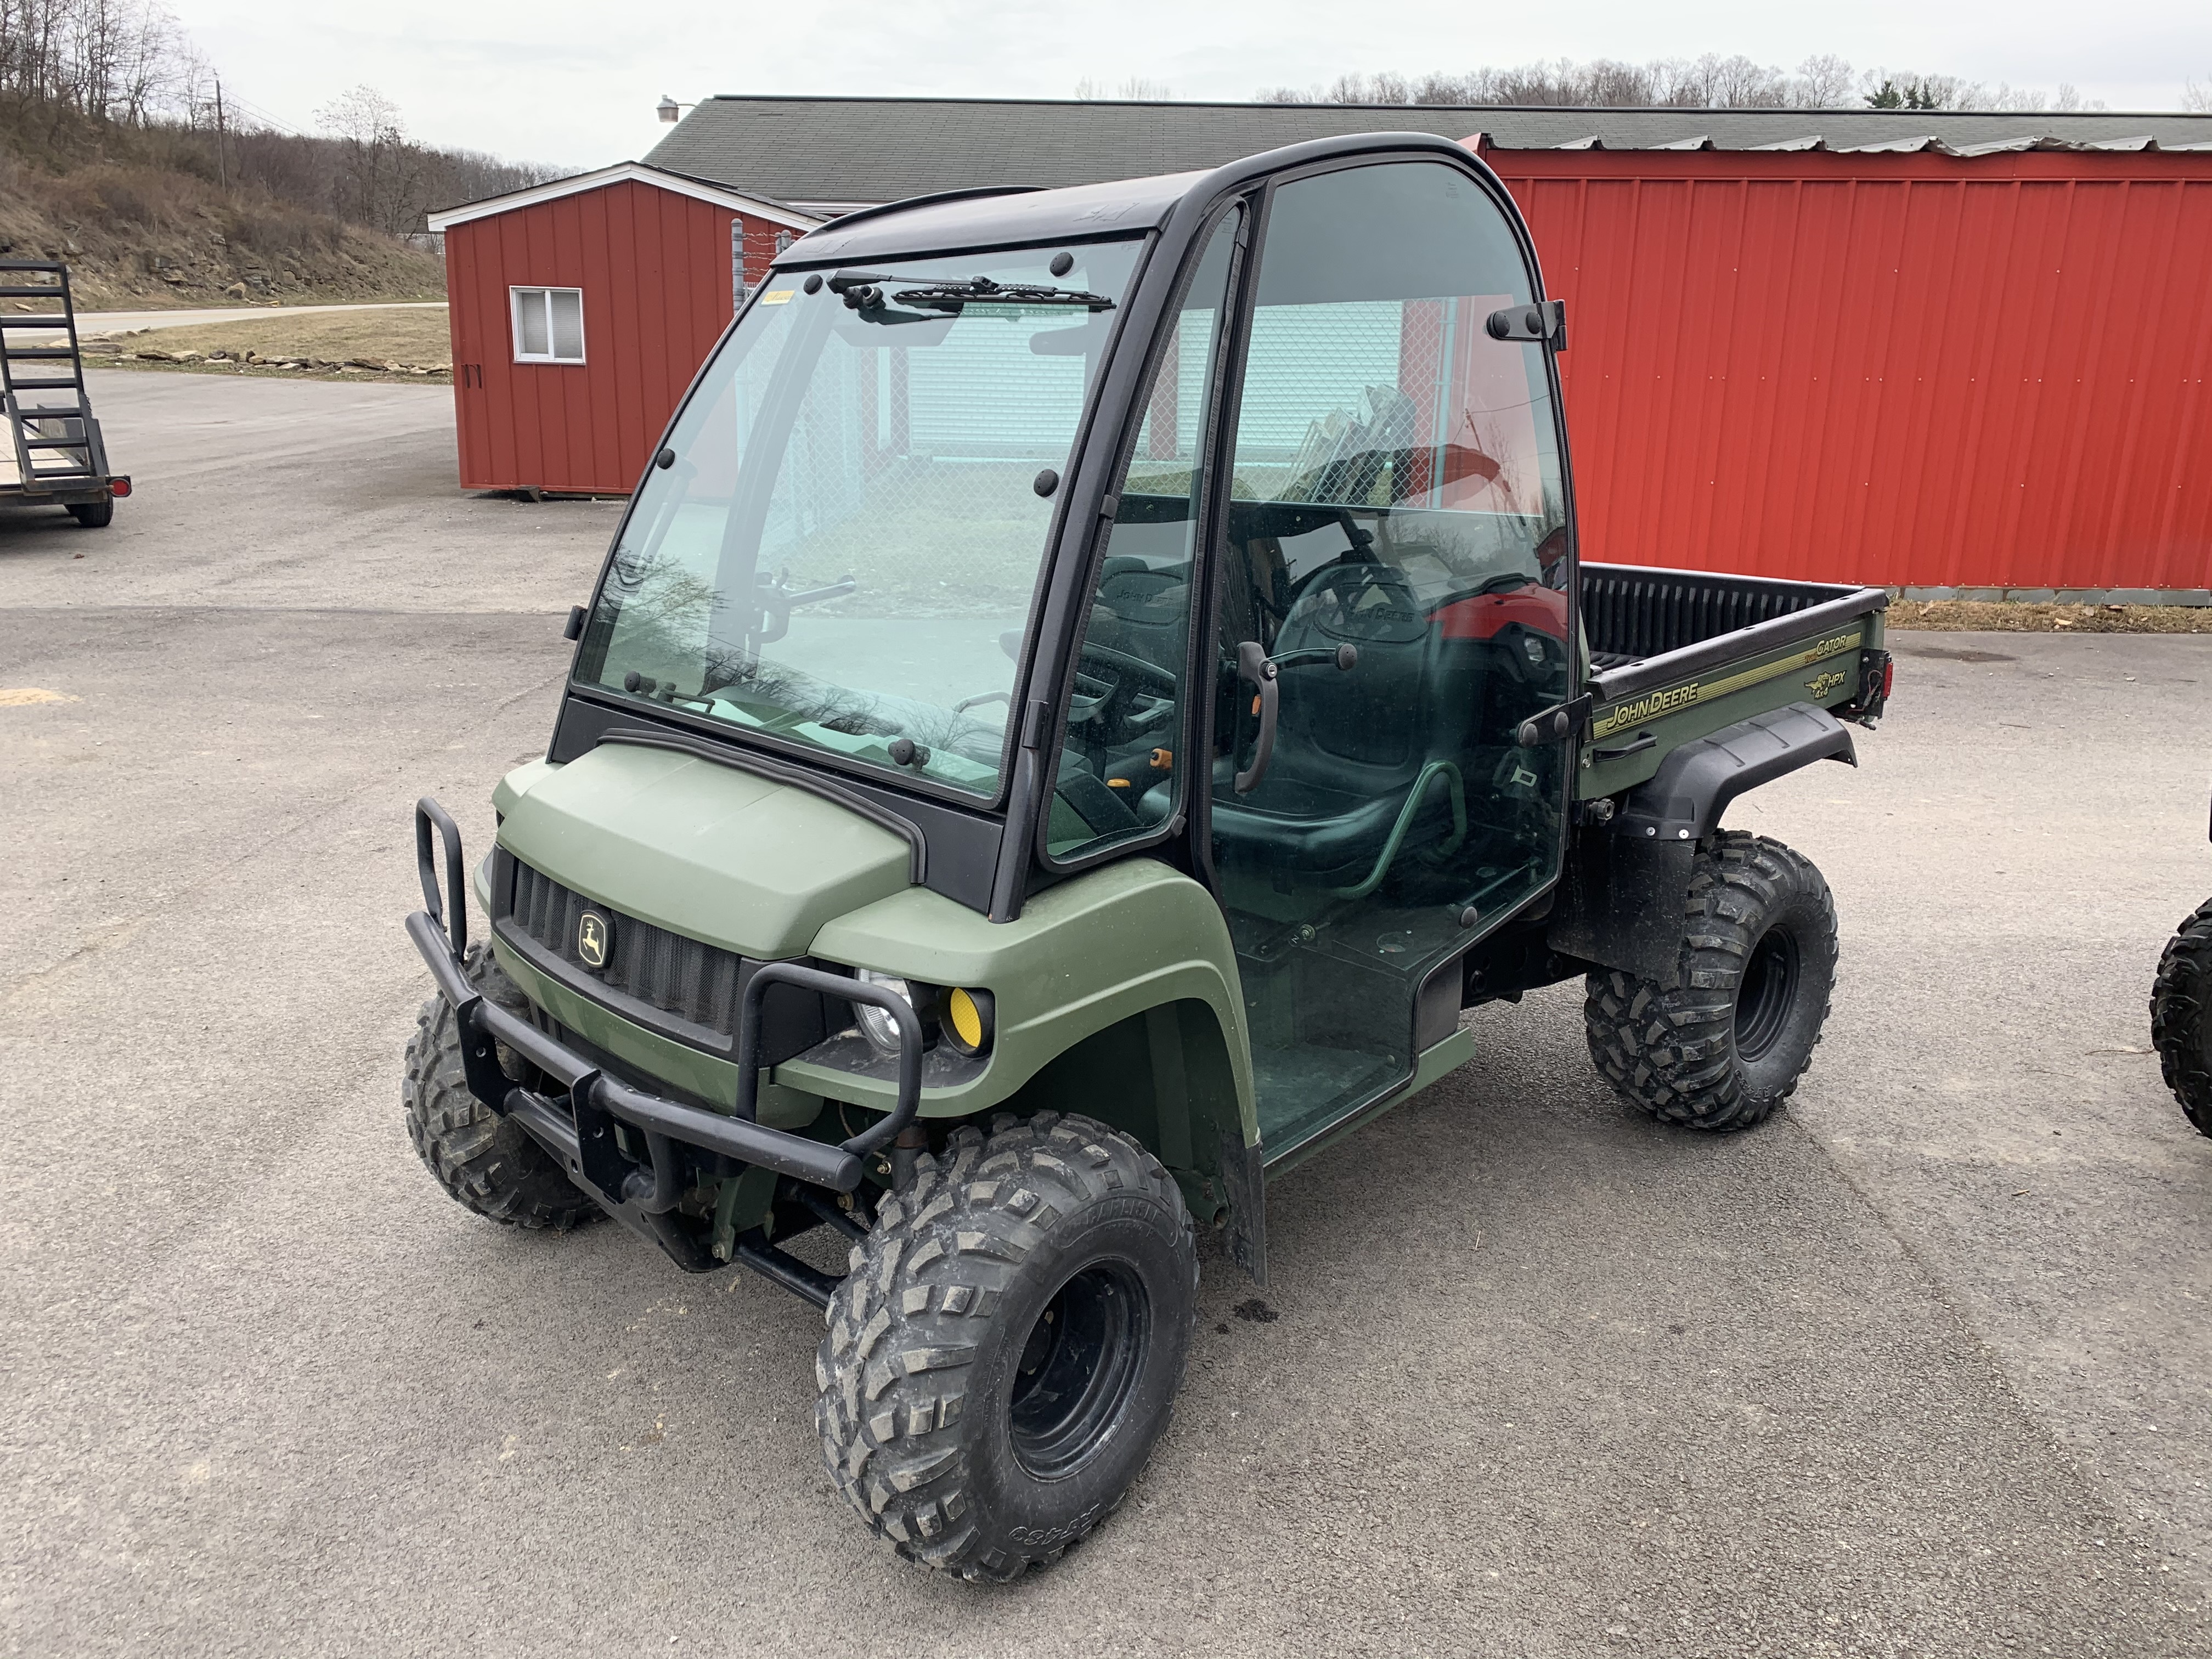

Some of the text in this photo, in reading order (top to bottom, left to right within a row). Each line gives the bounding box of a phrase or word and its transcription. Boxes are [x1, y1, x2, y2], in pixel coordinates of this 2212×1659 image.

[1816, 635, 1847, 656] GATOR
[1827, 670, 1847, 688] HPX
[1814, 687, 1829, 699] 4x4
[1607, 682, 1699, 730] JOHN DEERE
